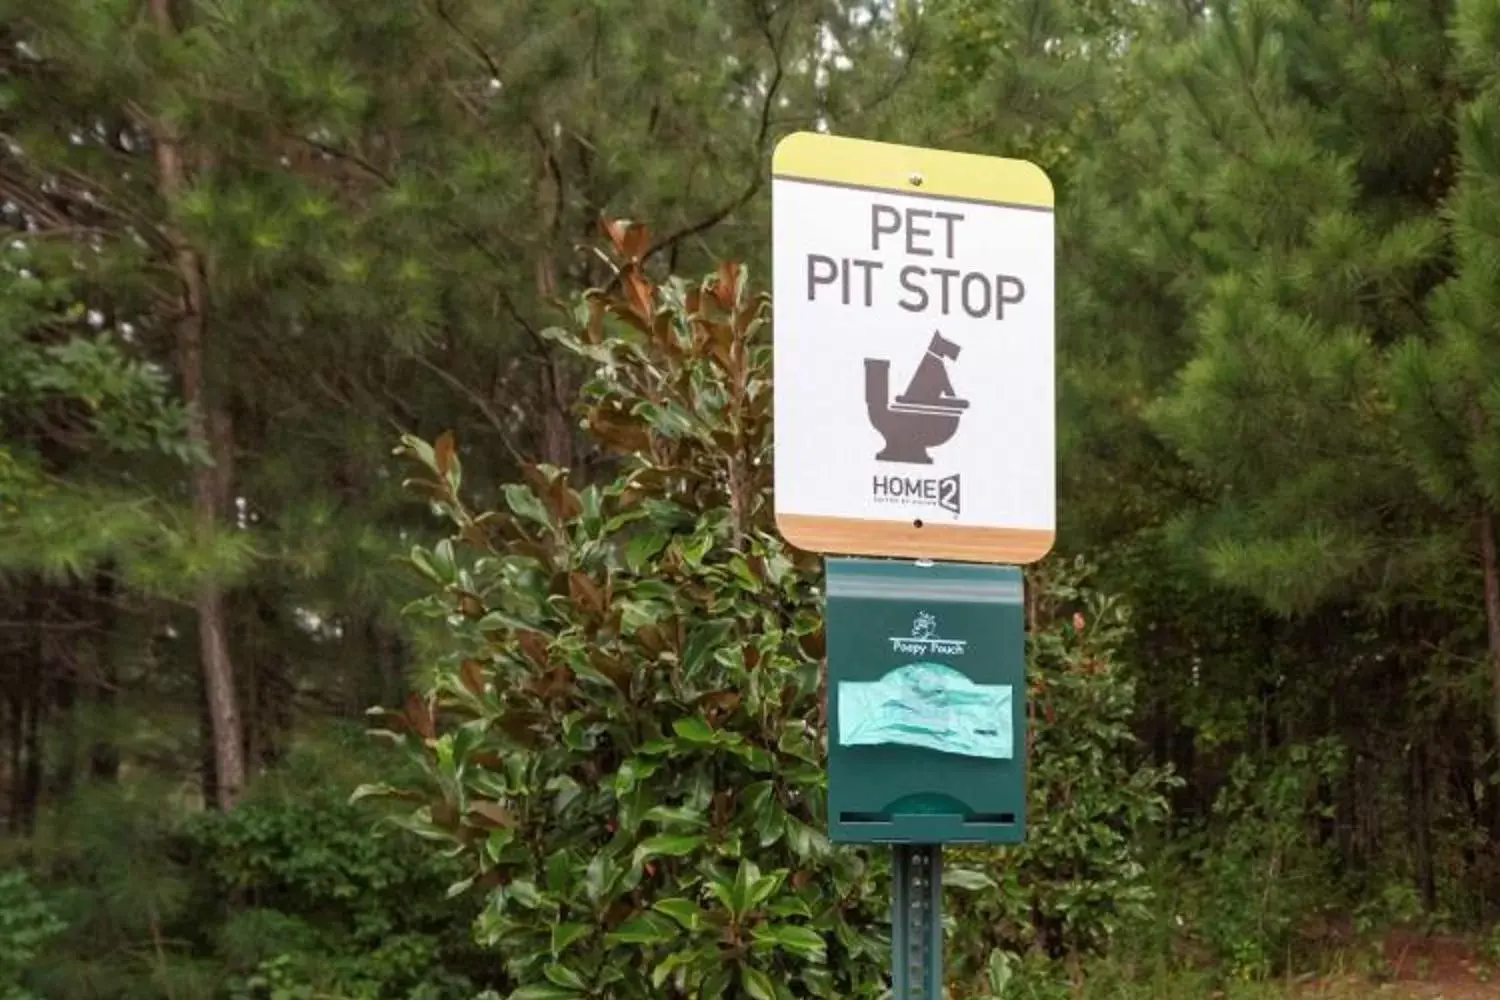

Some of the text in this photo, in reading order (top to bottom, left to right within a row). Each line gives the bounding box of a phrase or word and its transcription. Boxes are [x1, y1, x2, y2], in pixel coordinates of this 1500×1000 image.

[871, 203, 965, 258] PET
[807, 254, 1026, 320] PIT STOP
